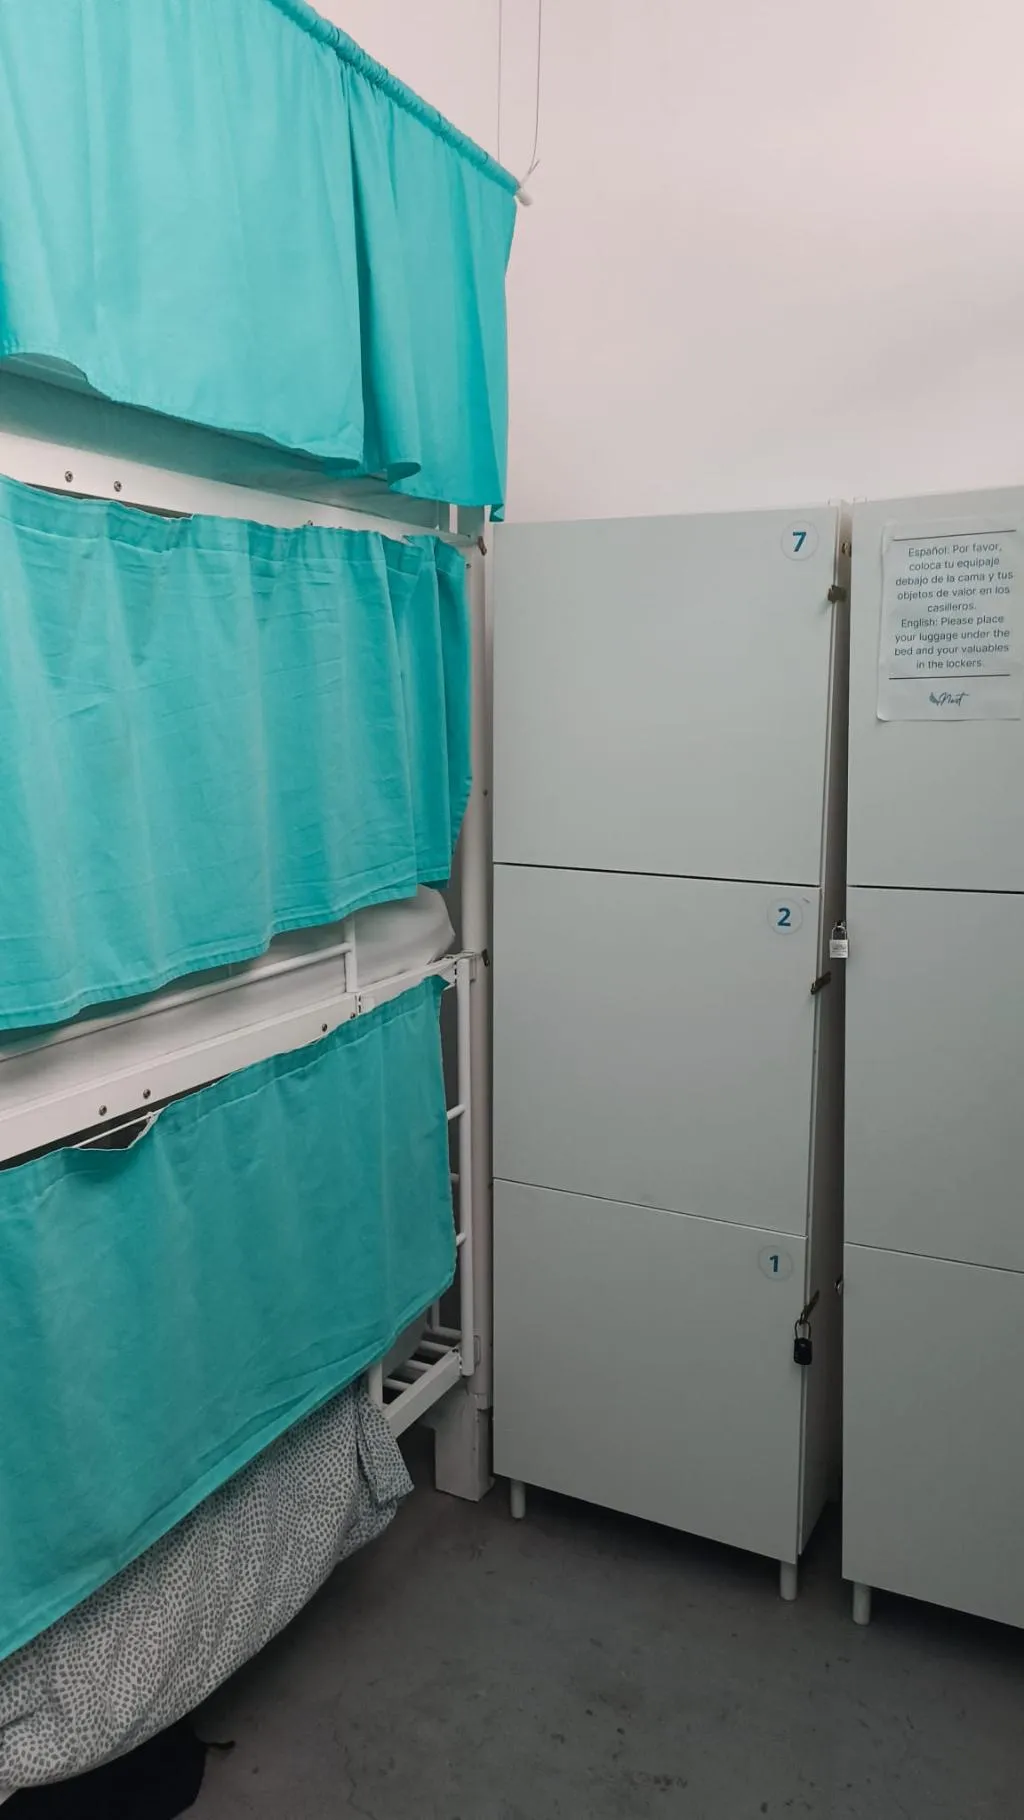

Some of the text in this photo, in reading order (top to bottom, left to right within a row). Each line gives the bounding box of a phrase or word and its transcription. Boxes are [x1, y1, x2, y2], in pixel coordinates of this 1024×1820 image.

[792, 531, 807, 552] 7
[908, 546, 950, 558] Español:
[952, 544, 969, 554] Por
[909, 557, 1001, 571] coloca tu equipaje
[895, 571, 1014, 587] debajo de la cama y tus
[897, 585, 1011, 601] objetos de valor en los
[927, 602, 977, 613] casilleros.
[901, 614, 1005, 629] English: Please place
[894, 628, 1011, 644] your luggage under the
[894, 643, 1010, 656] bed and your valuables
[916, 659, 926, 669] in
[928, 659, 944, 669] the
[777, 907, 791, 927] 2
[769, 1254, 779, 1273] 1
